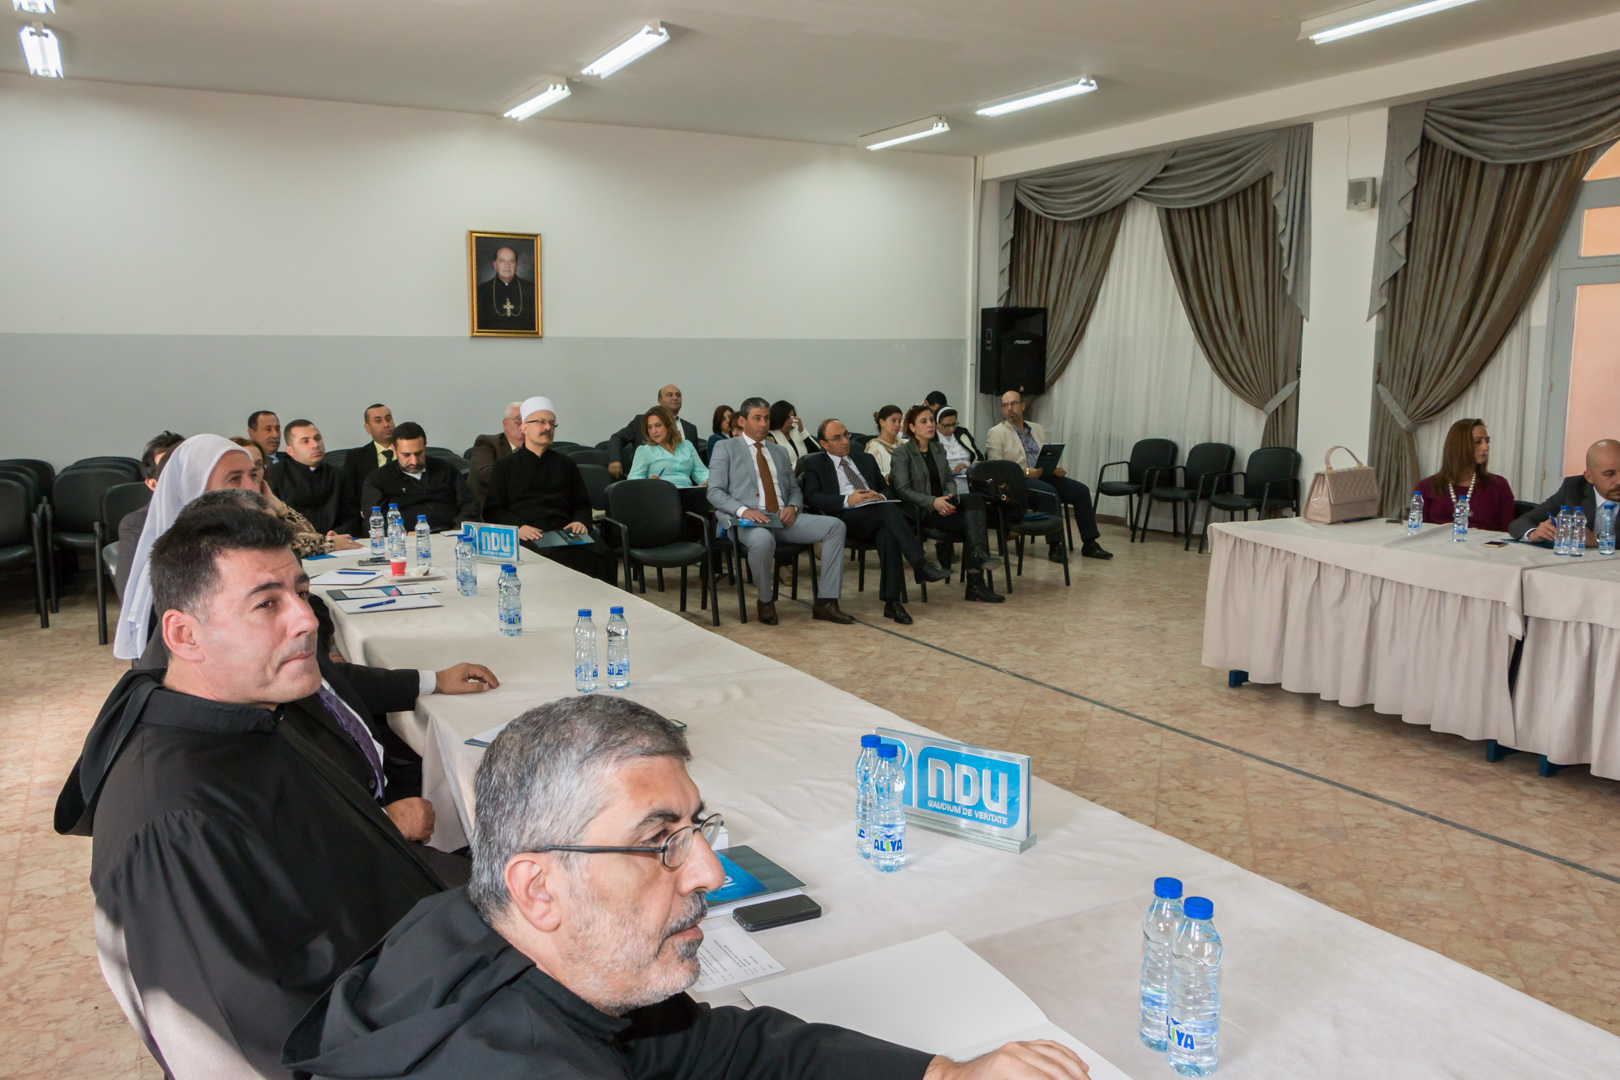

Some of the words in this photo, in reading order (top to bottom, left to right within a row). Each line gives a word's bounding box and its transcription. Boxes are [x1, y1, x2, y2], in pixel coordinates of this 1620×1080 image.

[928, 757, 1008, 815] NDU
[927, 799, 961, 814] GAUDIUM
[962, 807, 973, 817] DE
[974, 810, 1008, 825] VERITATE
[874, 838, 903, 852] ALIYA
[1168, 1024, 1195, 1050] LIYA
